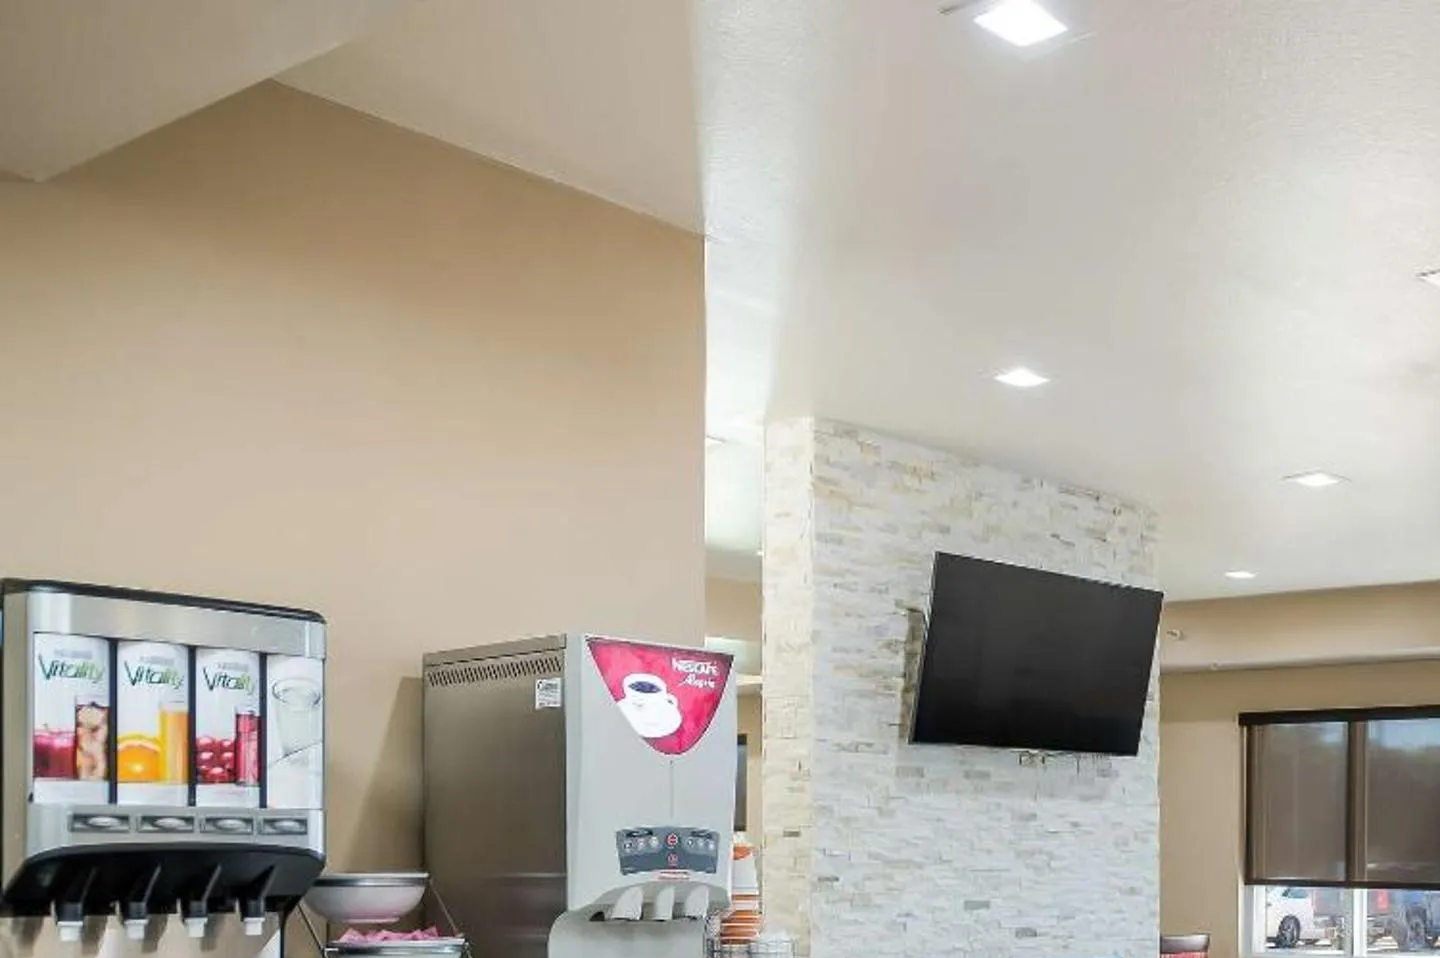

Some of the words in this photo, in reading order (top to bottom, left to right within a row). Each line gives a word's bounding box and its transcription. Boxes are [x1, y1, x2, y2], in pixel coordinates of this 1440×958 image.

[38, 652, 104, 684] Vitality
[124, 659, 186, 690] Vitality
[202, 665, 255, 696] Vitality
